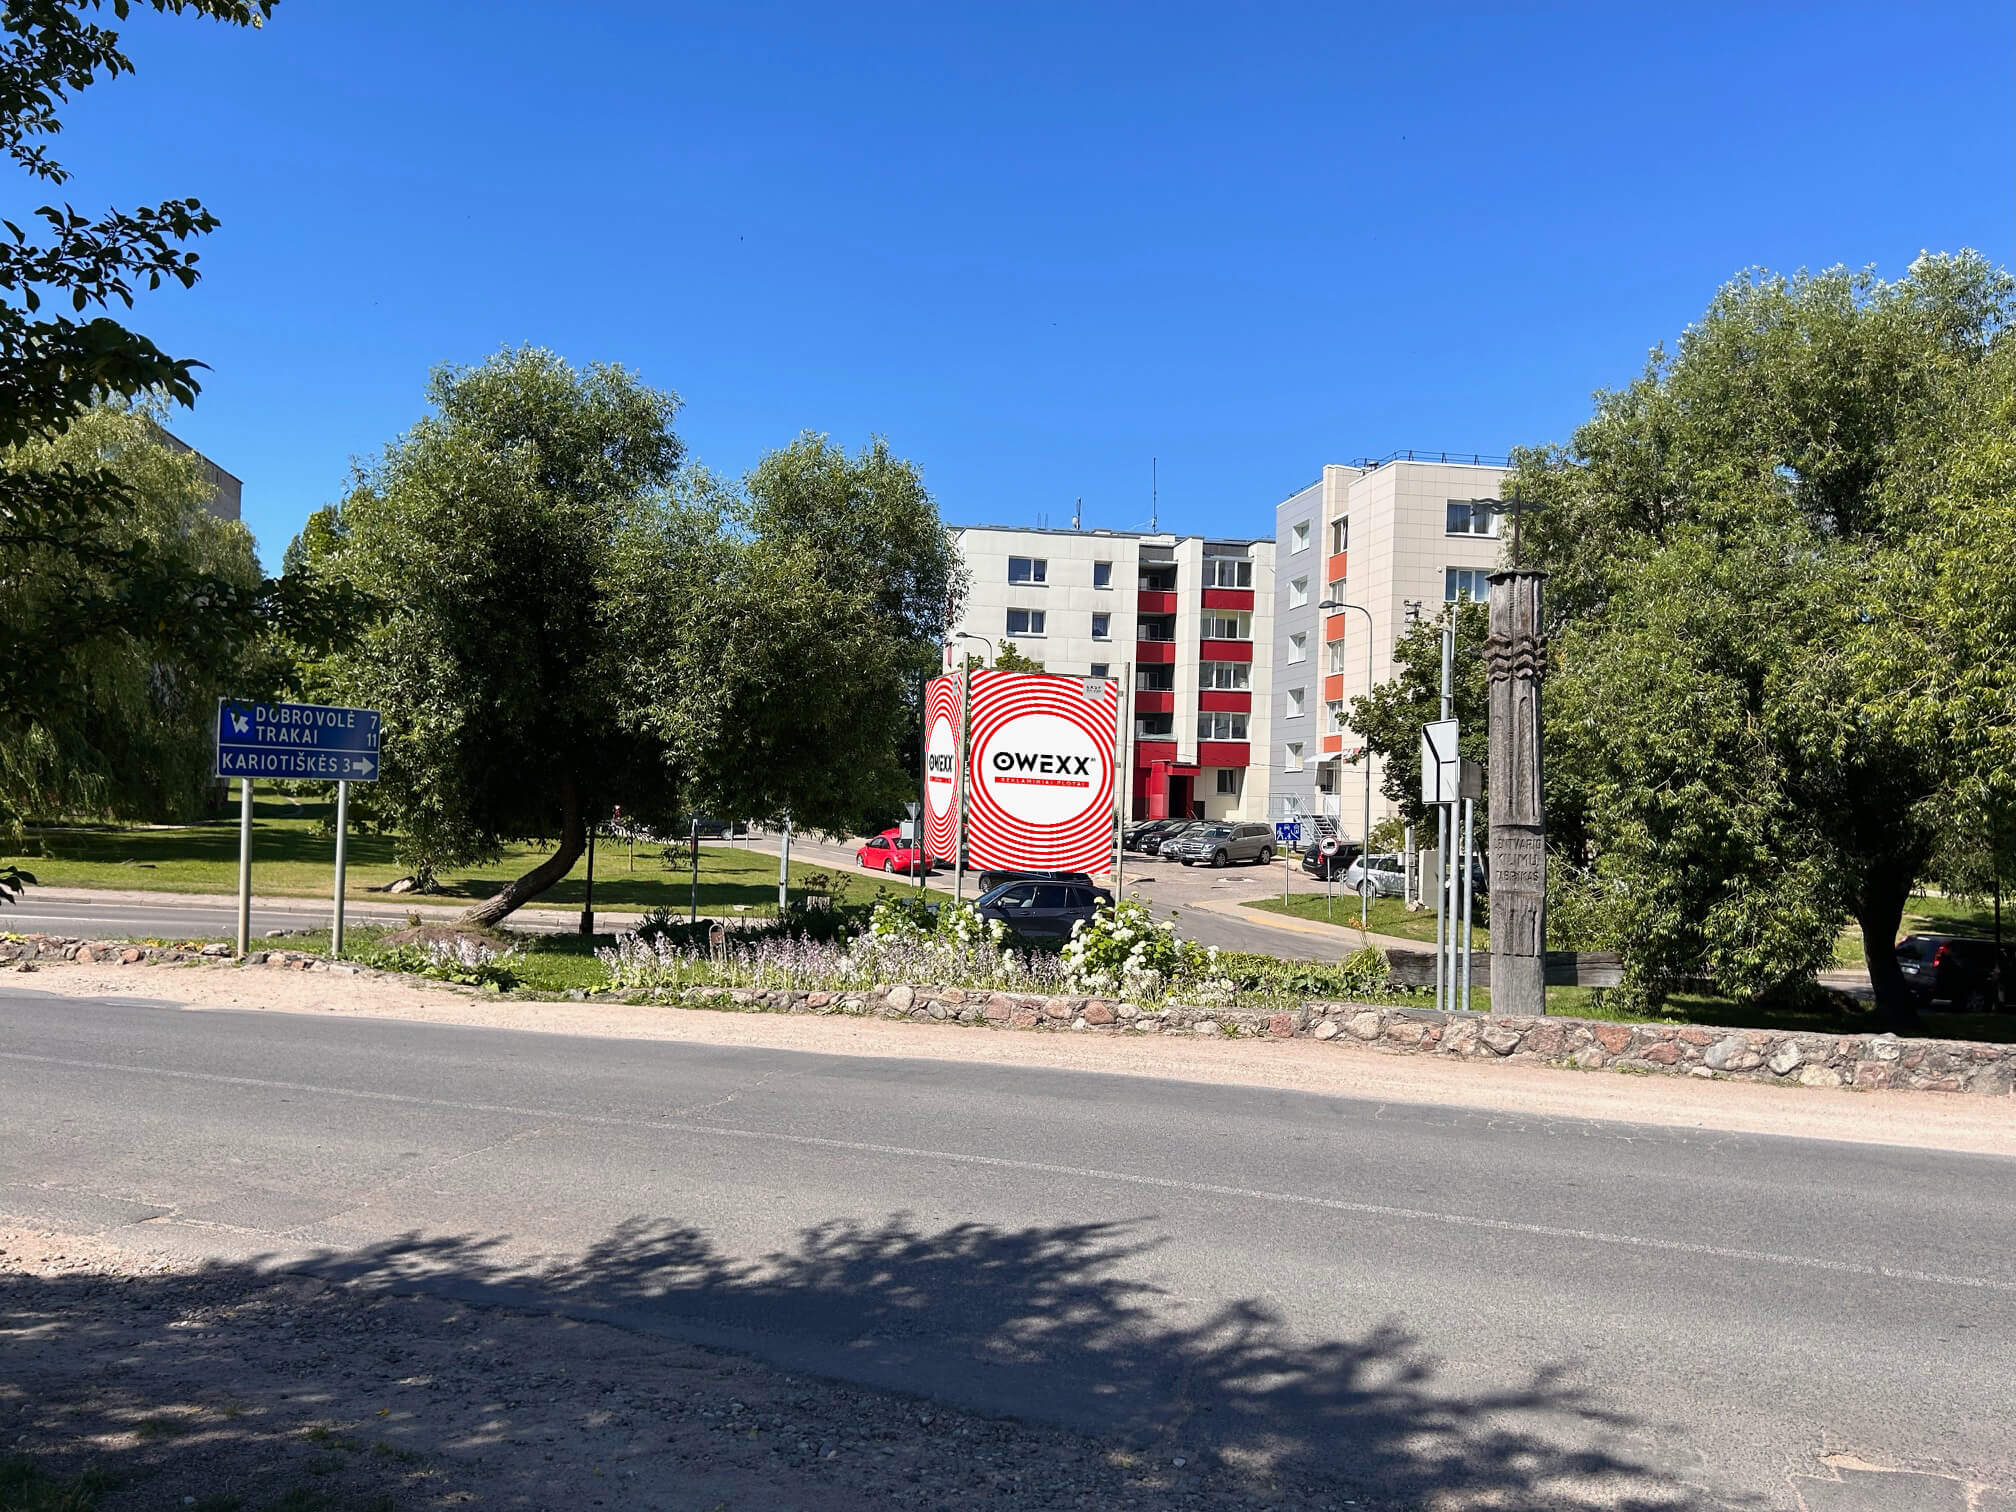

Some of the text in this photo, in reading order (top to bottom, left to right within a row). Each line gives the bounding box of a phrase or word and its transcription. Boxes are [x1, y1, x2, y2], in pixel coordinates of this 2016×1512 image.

[370, 715, 378, 729] 7
[256, 726, 377, 748] TRAKAI 11
[222, 751, 351, 773] KARIOTIŠKĖS 3
[993, 751, 1090, 776] OWEXX
